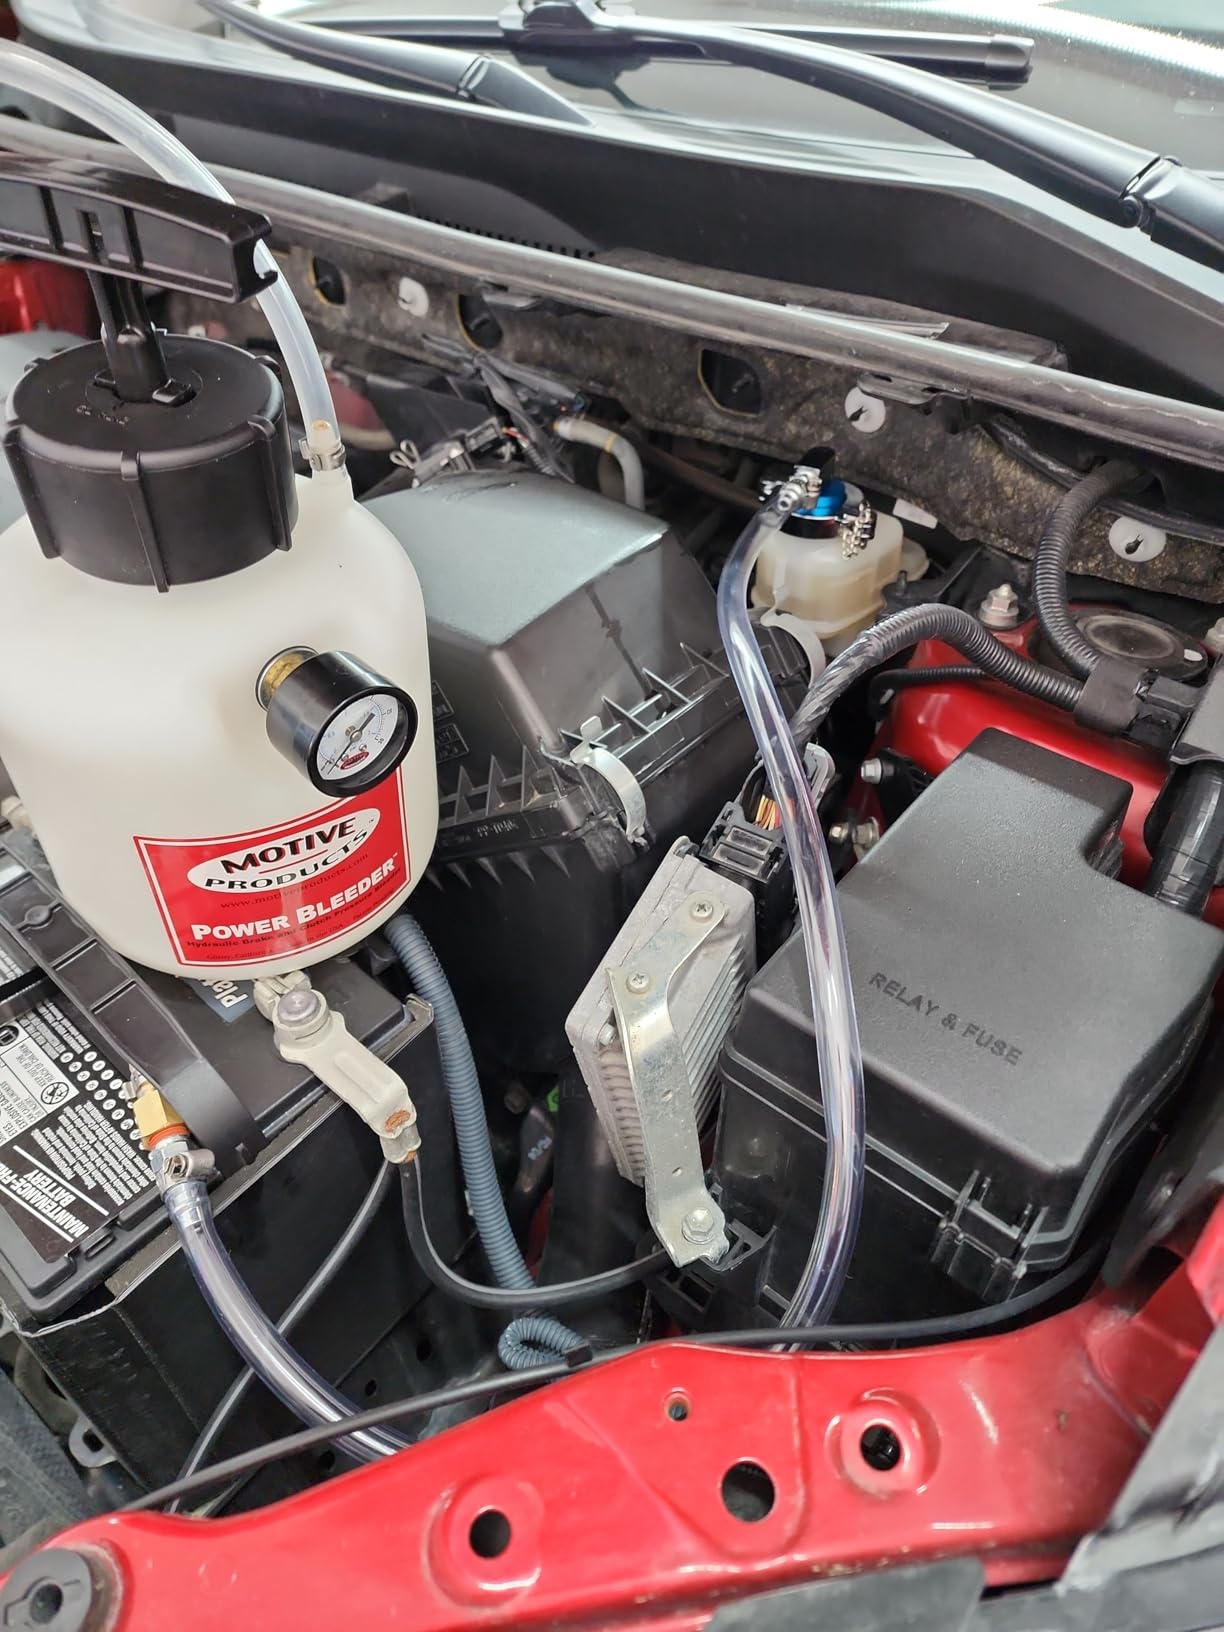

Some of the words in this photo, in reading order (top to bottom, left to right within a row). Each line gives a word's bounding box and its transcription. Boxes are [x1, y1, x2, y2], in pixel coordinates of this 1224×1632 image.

[205, 829, 367, 889] PRODUCTS
[220, 817, 356, 874] MOTIVE
[191, 915, 290, 940] POWER
[296, 858, 395, 924] BLEEDER
[869, 972, 940, 1016] RELAY
[941, 1013, 958, 1031] &
[961, 1023, 1023, 1067] FUSE
[23, 1169, 77, 1208] BATTERY
